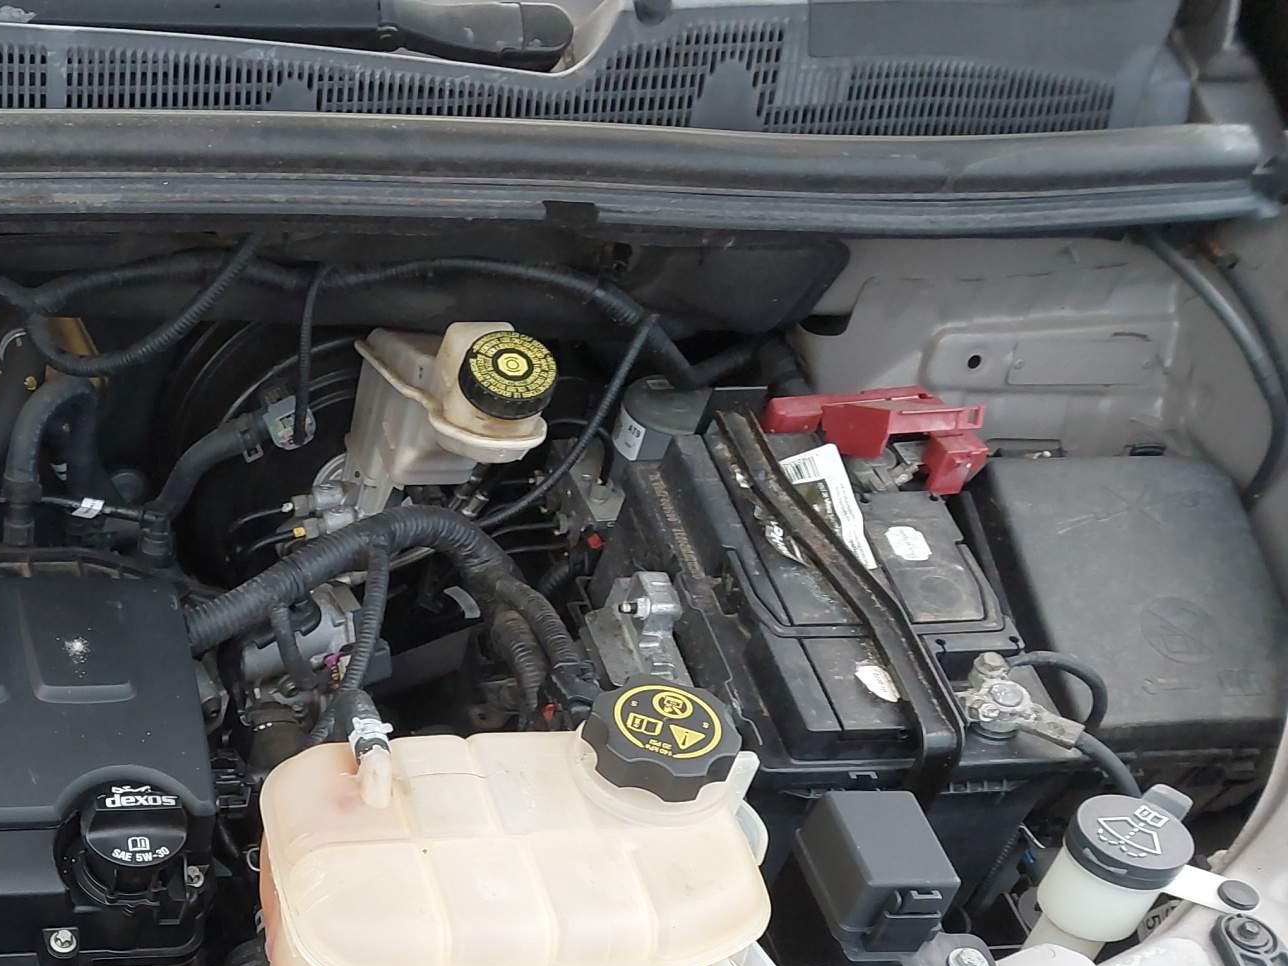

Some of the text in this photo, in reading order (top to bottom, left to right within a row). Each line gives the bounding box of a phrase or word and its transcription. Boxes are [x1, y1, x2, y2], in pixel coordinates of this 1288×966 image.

[105, 793, 178, 808] dexos
[112, 846, 170, 862] SAE 5W-30
